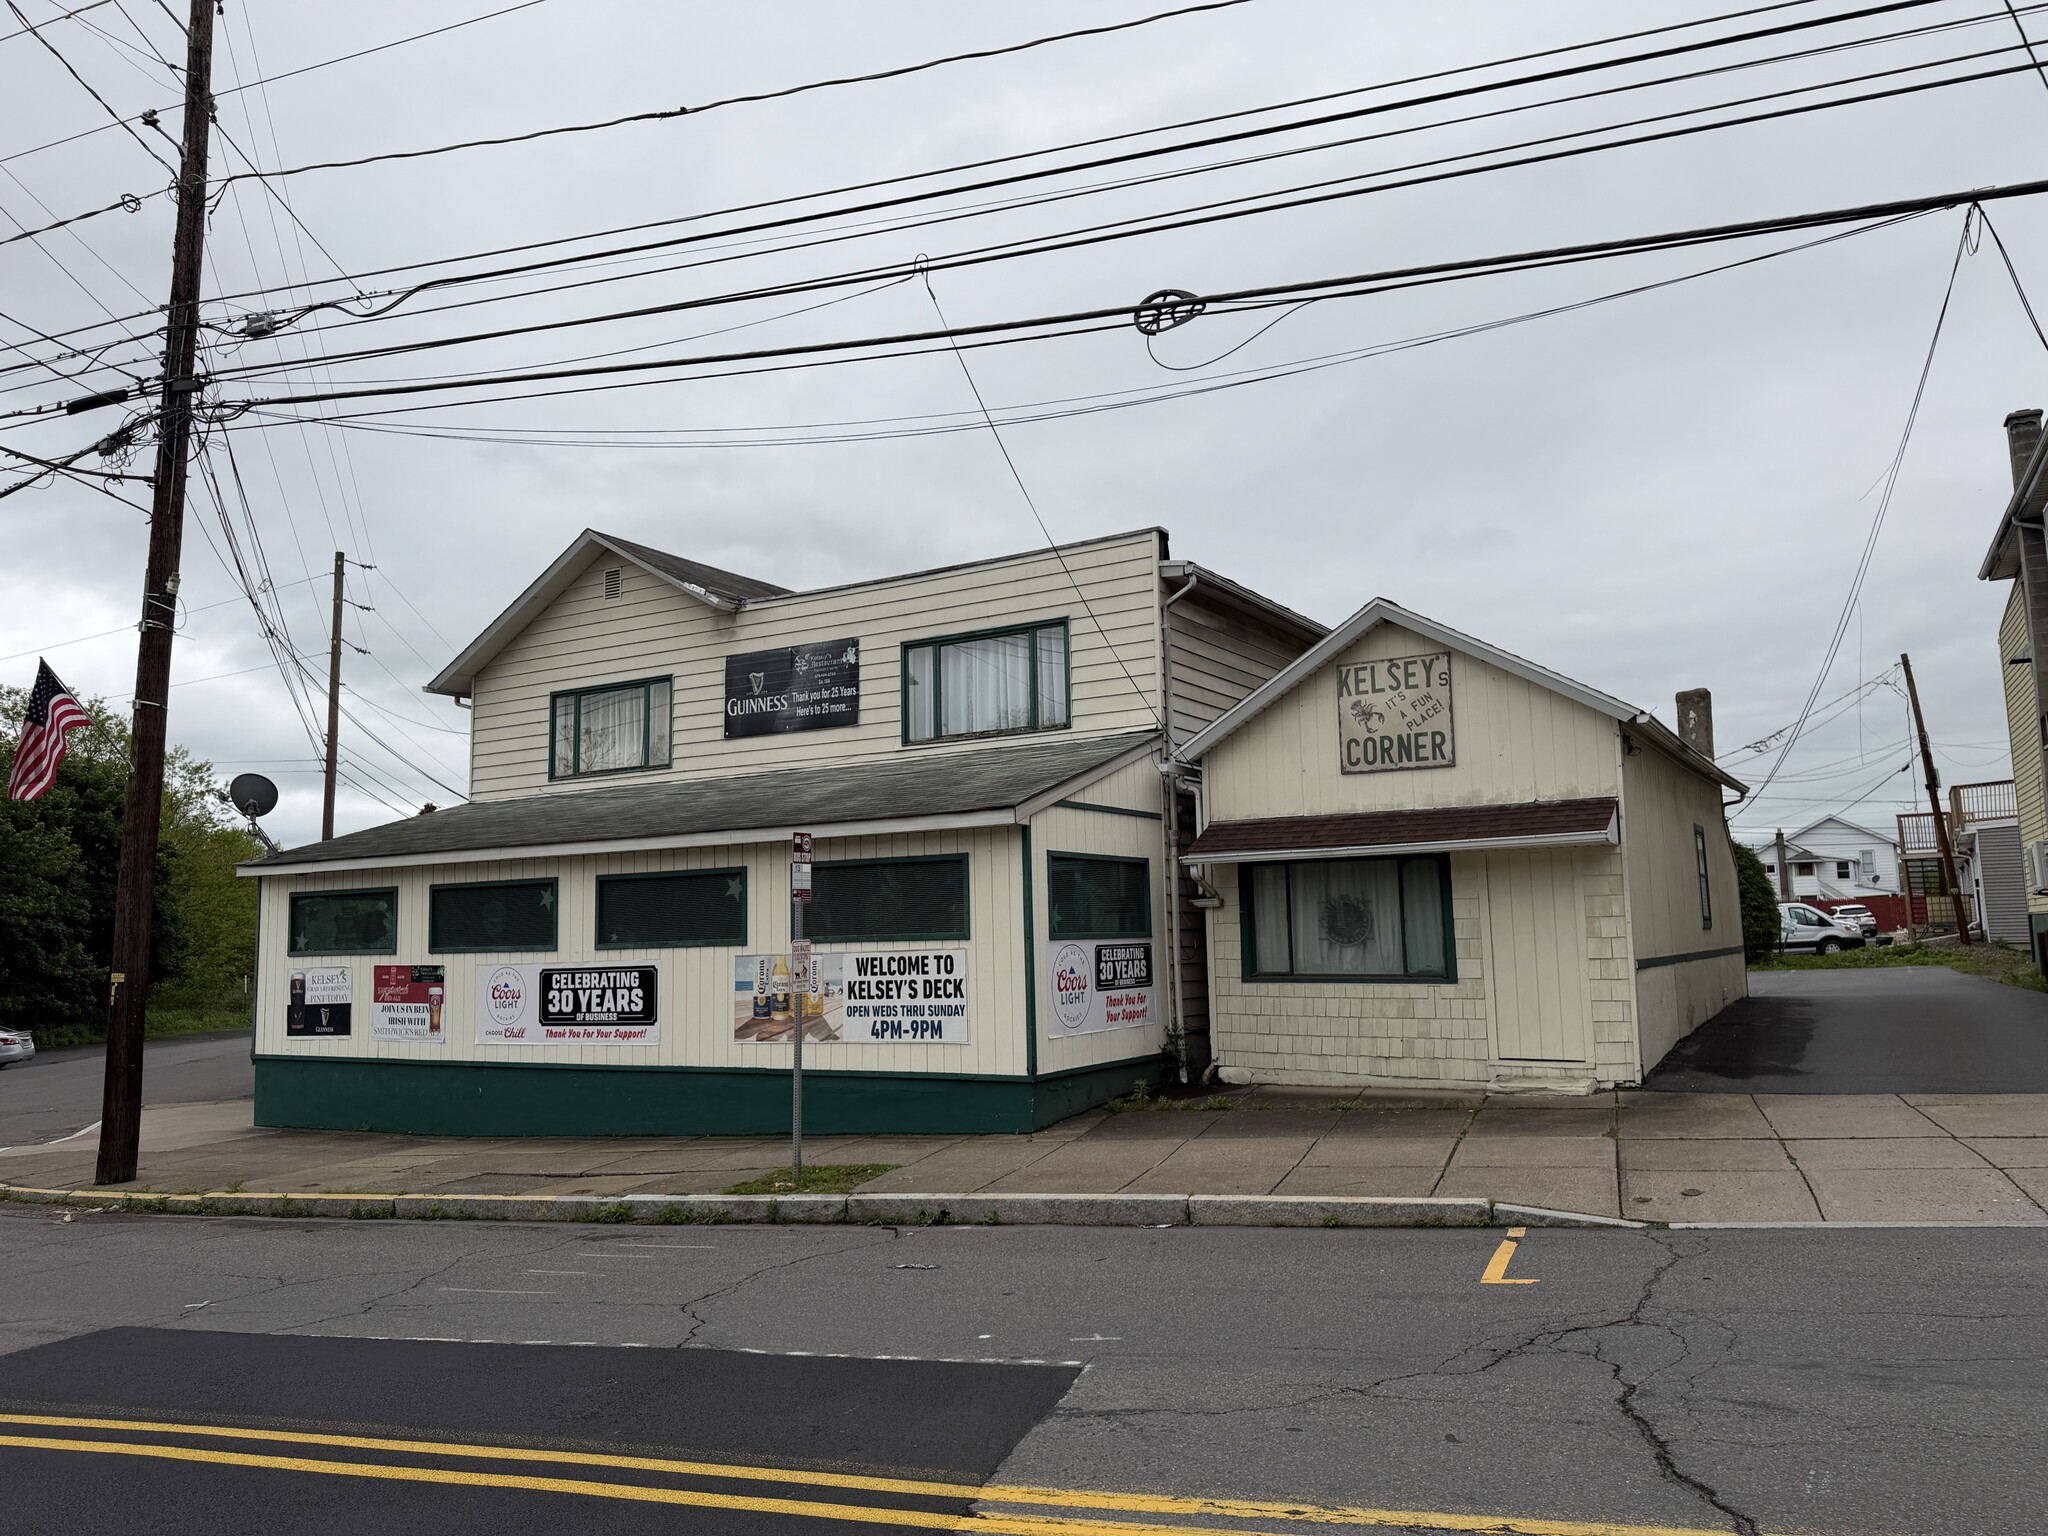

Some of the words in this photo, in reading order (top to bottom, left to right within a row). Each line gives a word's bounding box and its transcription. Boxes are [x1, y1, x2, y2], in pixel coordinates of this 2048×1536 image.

[1338, 655, 1449, 698] KELSEY'S
[792, 691, 810, 703] Thank
[809, 691, 821, 704] you
[821, 688, 831, 699] for
[831, 687, 839, 697] 25
[840, 686, 857, 697] Years
[1385, 691, 1407, 710] IT'S
[727, 695, 788, 716] GUINNESS
[796, 706, 814, 717] Here's
[814, 704, 821, 715] to
[821, 703, 830, 714] 25
[830, 703, 852, 713] more...
[1400, 710, 1408, 720] A
[1411, 692, 1434, 712] FUN
[1406, 699, 1445, 732] PLACE!
[1346, 731, 1447, 767] CORNER
[1101, 947, 1145, 961] CELEBRATING
[856, 955, 929, 976] WELCOME
[934, 954, 955, 975] TO
[1100, 961, 1114, 980] 30
[1114, 960, 1147, 979] YEARS
[312, 974, 347, 985] KELSEY'S
[552, 971, 640, 989] CELEBRATING
[757, 960, 766, 995] Corona
[810, 960, 819, 993] Corona
[1056, 969, 1088, 993] Coors
[491, 983, 522, 1000] Coors
[847, 979, 918, 1000] KELSEY'S
[923, 978, 965, 999] DECK
[310, 994, 326, 1003] PINT
[326, 993, 349, 1003] TODAY
[494, 1000, 519, 1009] LIGHT
[548, 989, 574, 1013] 30
[577, 988, 644, 1013] YEARS
[1061, 991, 1085, 1005] LIGHT
[1106, 994, 1124, 1008] Thank
[1125, 994, 1136, 1006] You
[1137, 992, 1147, 1004] For
[380, 1005, 396, 1013] JOIN
[396, 1005, 405, 1013] US
[406, 1005, 413, 1013] IN
[576, 1013, 585, 1021] OF
[585, 1012, 618, 1021] BUSINESS
[846, 1005, 870, 1017] OPEN
[872, 1005, 898, 1017] WEDS
[900, 1004, 926, 1017] THRU
[928, 1004, 966, 1017] SUNDAY
[1106, 1010, 1121, 1023] Your
[1121, 1006, 1148, 1023] Support!
[388, 1017, 406, 1026] IRISH
[407, 1017, 426, 1026] WITH
[870, 1020, 943, 1040] 4PM-9PM
[414, 1028, 428, 1037] RED
[503, 1026, 527, 1039] Chill
[545, 1029, 566, 1039] Thank
[568, 1029, 581, 1039] You
[582, 1029, 595, 1039] For
[596, 1029, 613, 1039] Your
[613, 1028, 648, 1041] Support!
